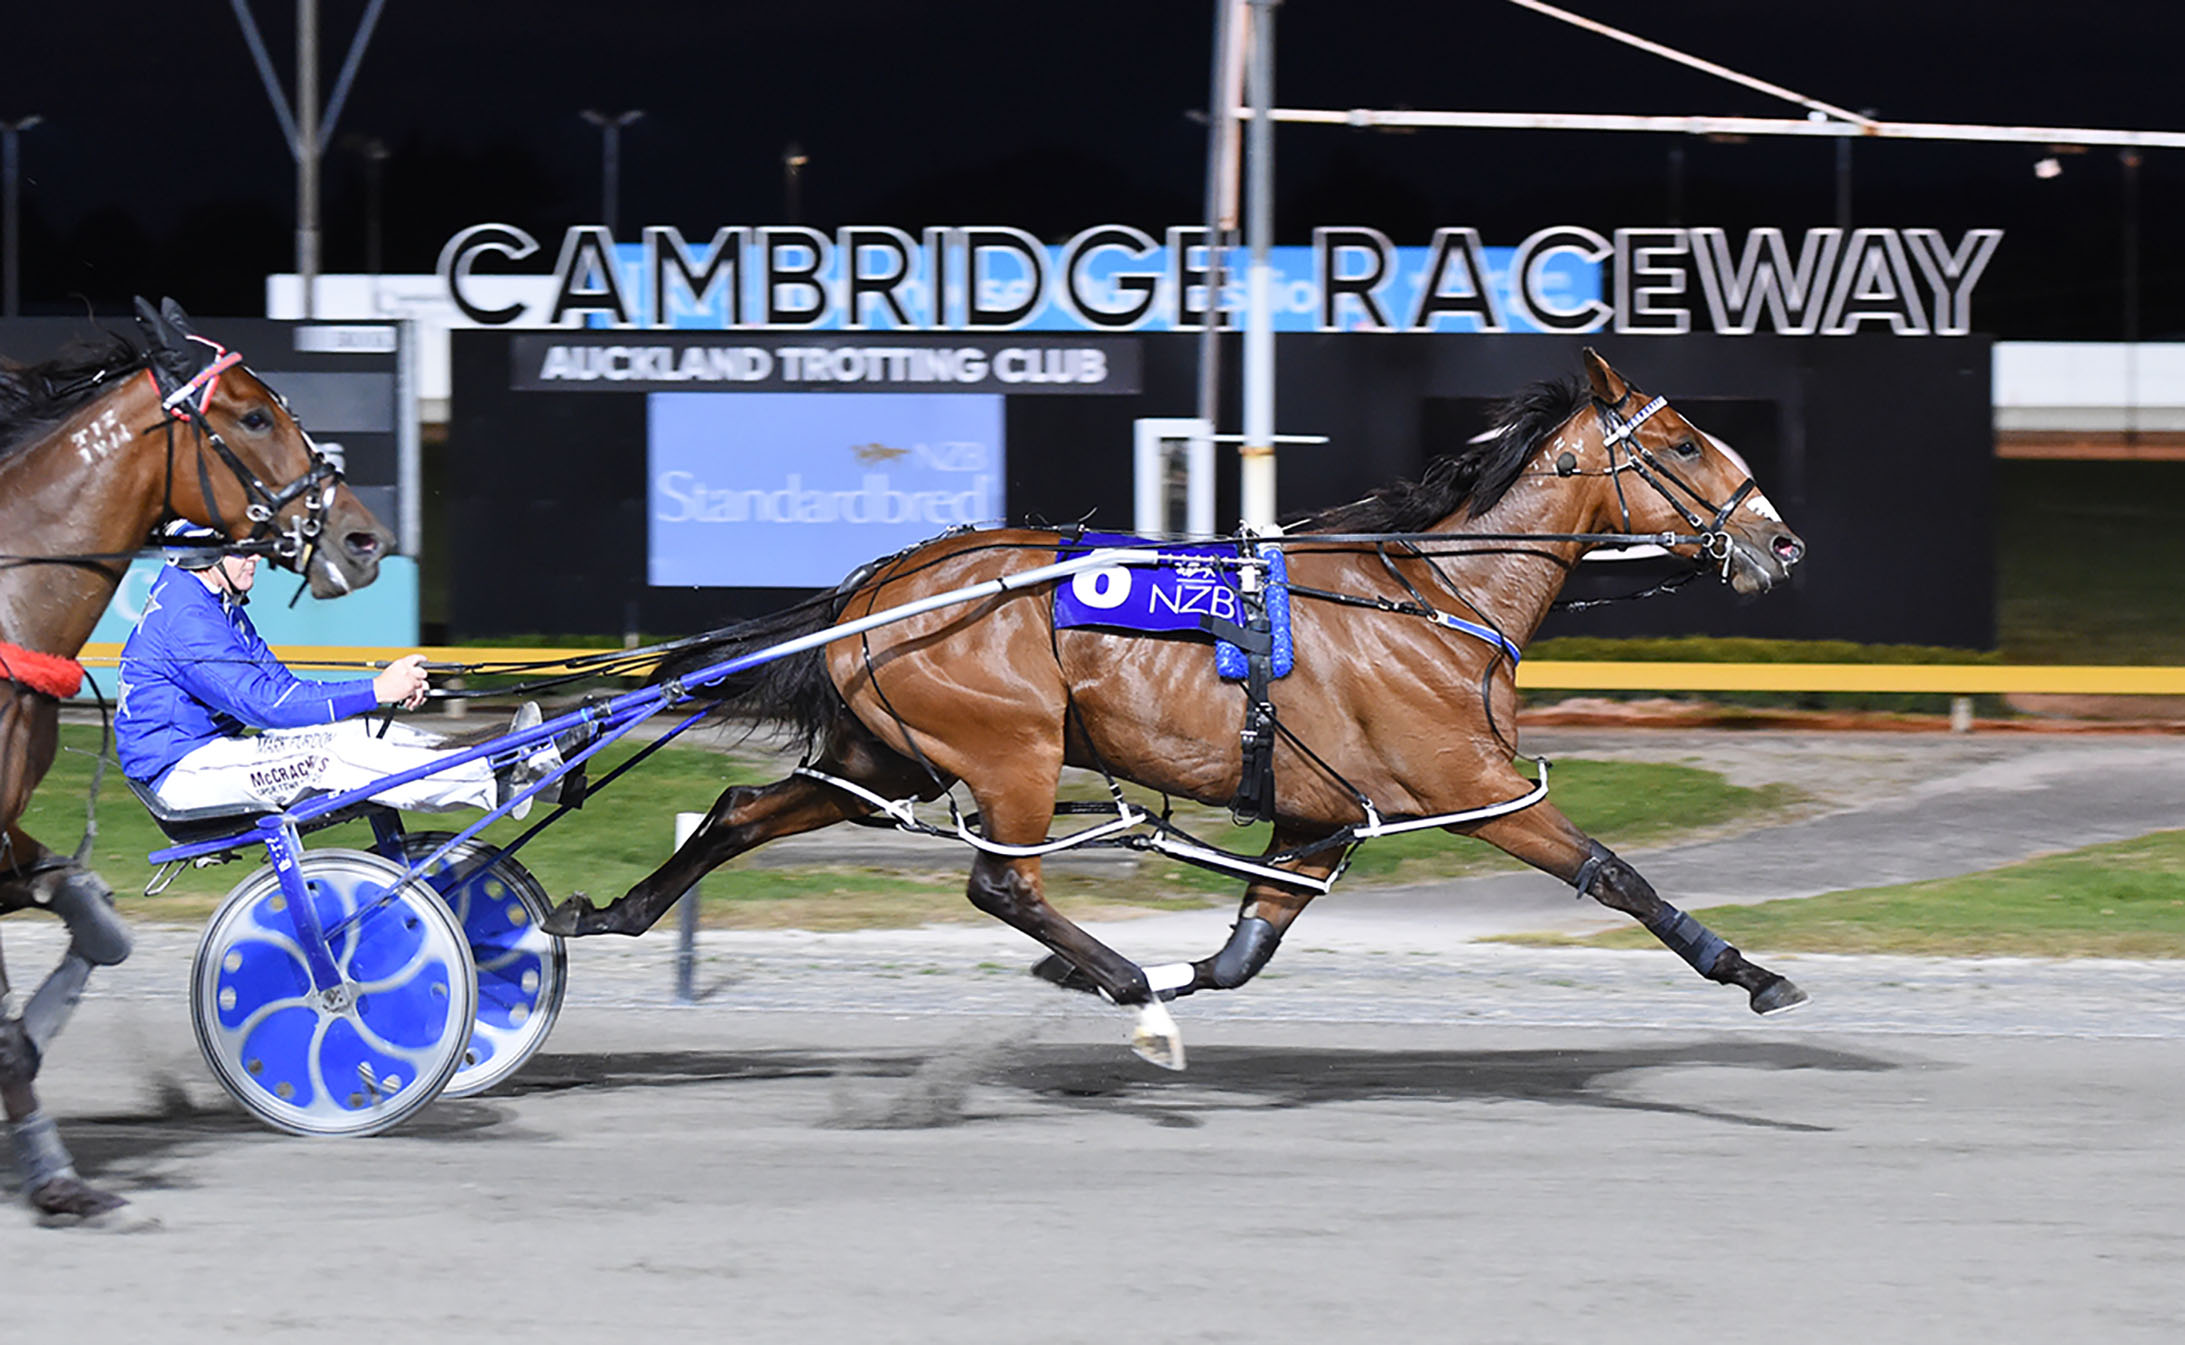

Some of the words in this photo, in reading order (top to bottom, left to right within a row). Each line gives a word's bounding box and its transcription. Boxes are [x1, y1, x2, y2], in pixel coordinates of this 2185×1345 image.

[436, 222, 1239, 332] CAMBRIDGE
[1312, 225, 2005, 336] RACEWAY
[540, 345, 774, 382] AUCKLAND
[776, 347, 988, 383] TROTTING
[992, 348, 1108, 384] CLUB
[655, 470, 994, 524] Standardbred
[1149, 584, 1236, 619] NZB
